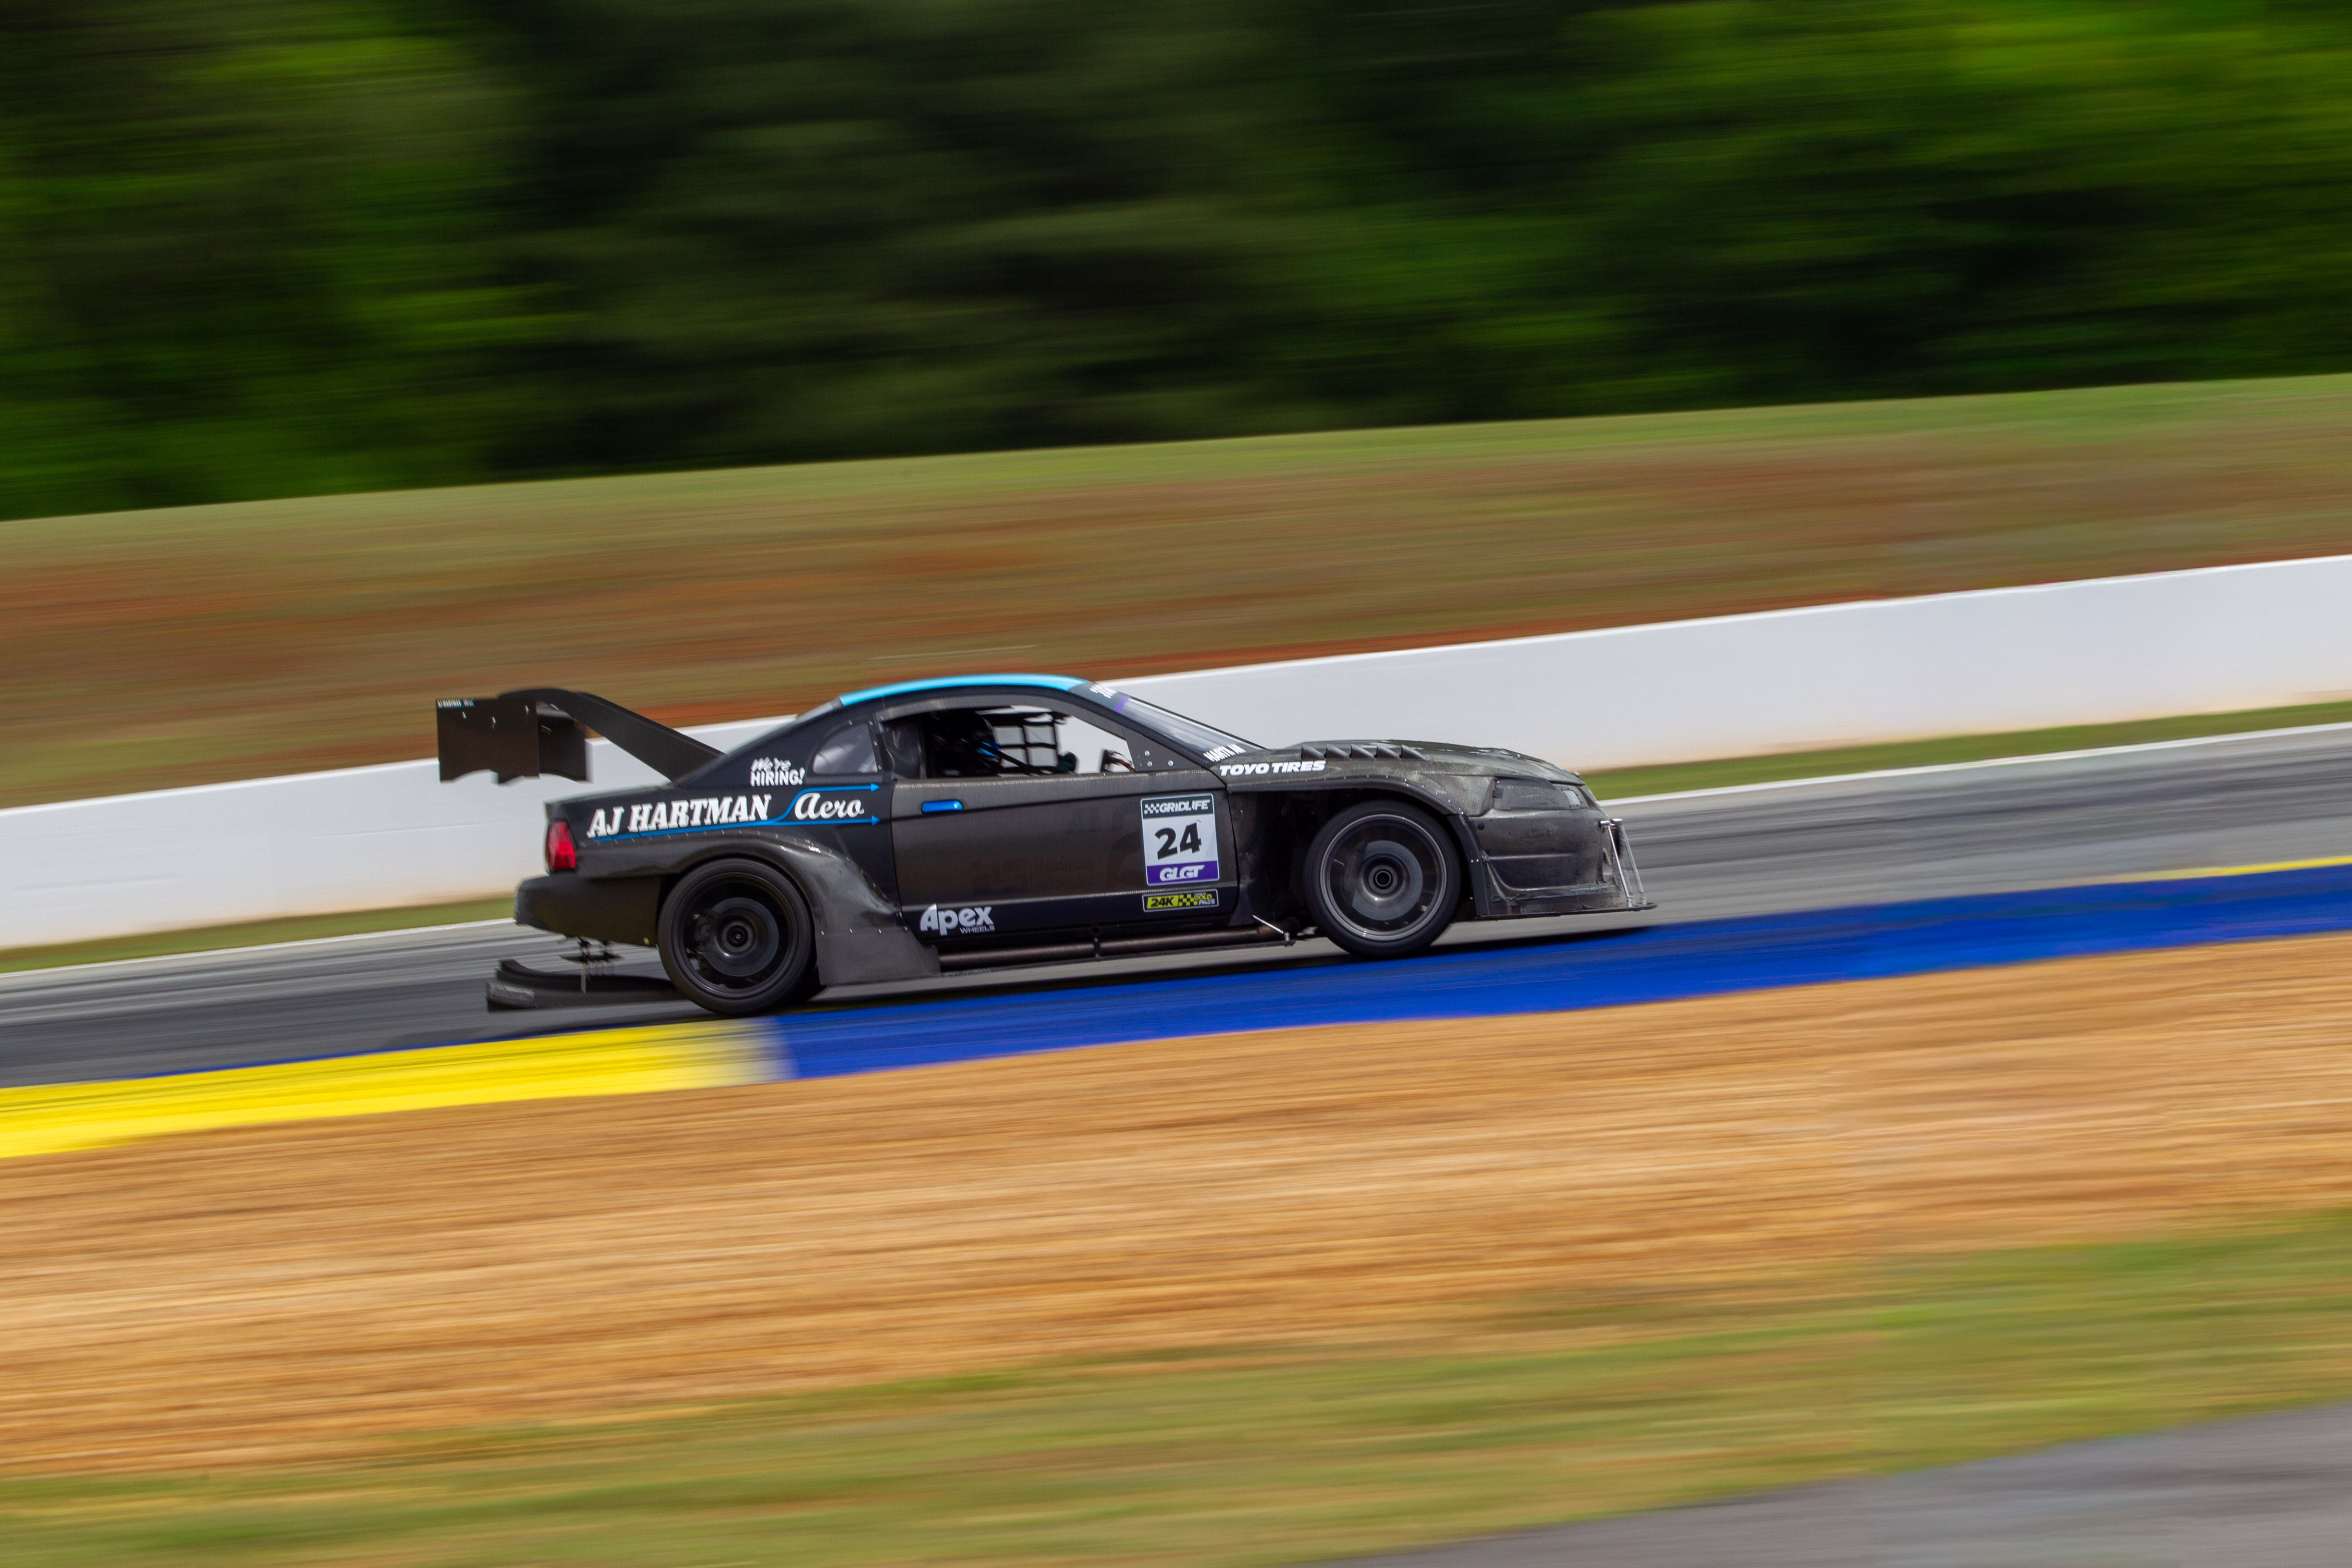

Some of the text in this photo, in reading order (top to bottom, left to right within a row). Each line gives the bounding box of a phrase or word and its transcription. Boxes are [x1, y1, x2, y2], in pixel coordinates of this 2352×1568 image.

[750, 767, 805, 786] HIRING!
[1219, 760, 1326, 776] TOYO TIRES
[1159, 799, 1211, 813] GRIDLIFE
[586, 793, 865, 838] AJ HARTMAN Aero
[1154, 822, 1202, 860] 24
[1160, 865, 1205, 882] GLGT
[1150, 897, 1174, 907] 24K
[919, 903, 994, 936] Apex
[959, 925, 995, 934] WHEELS
